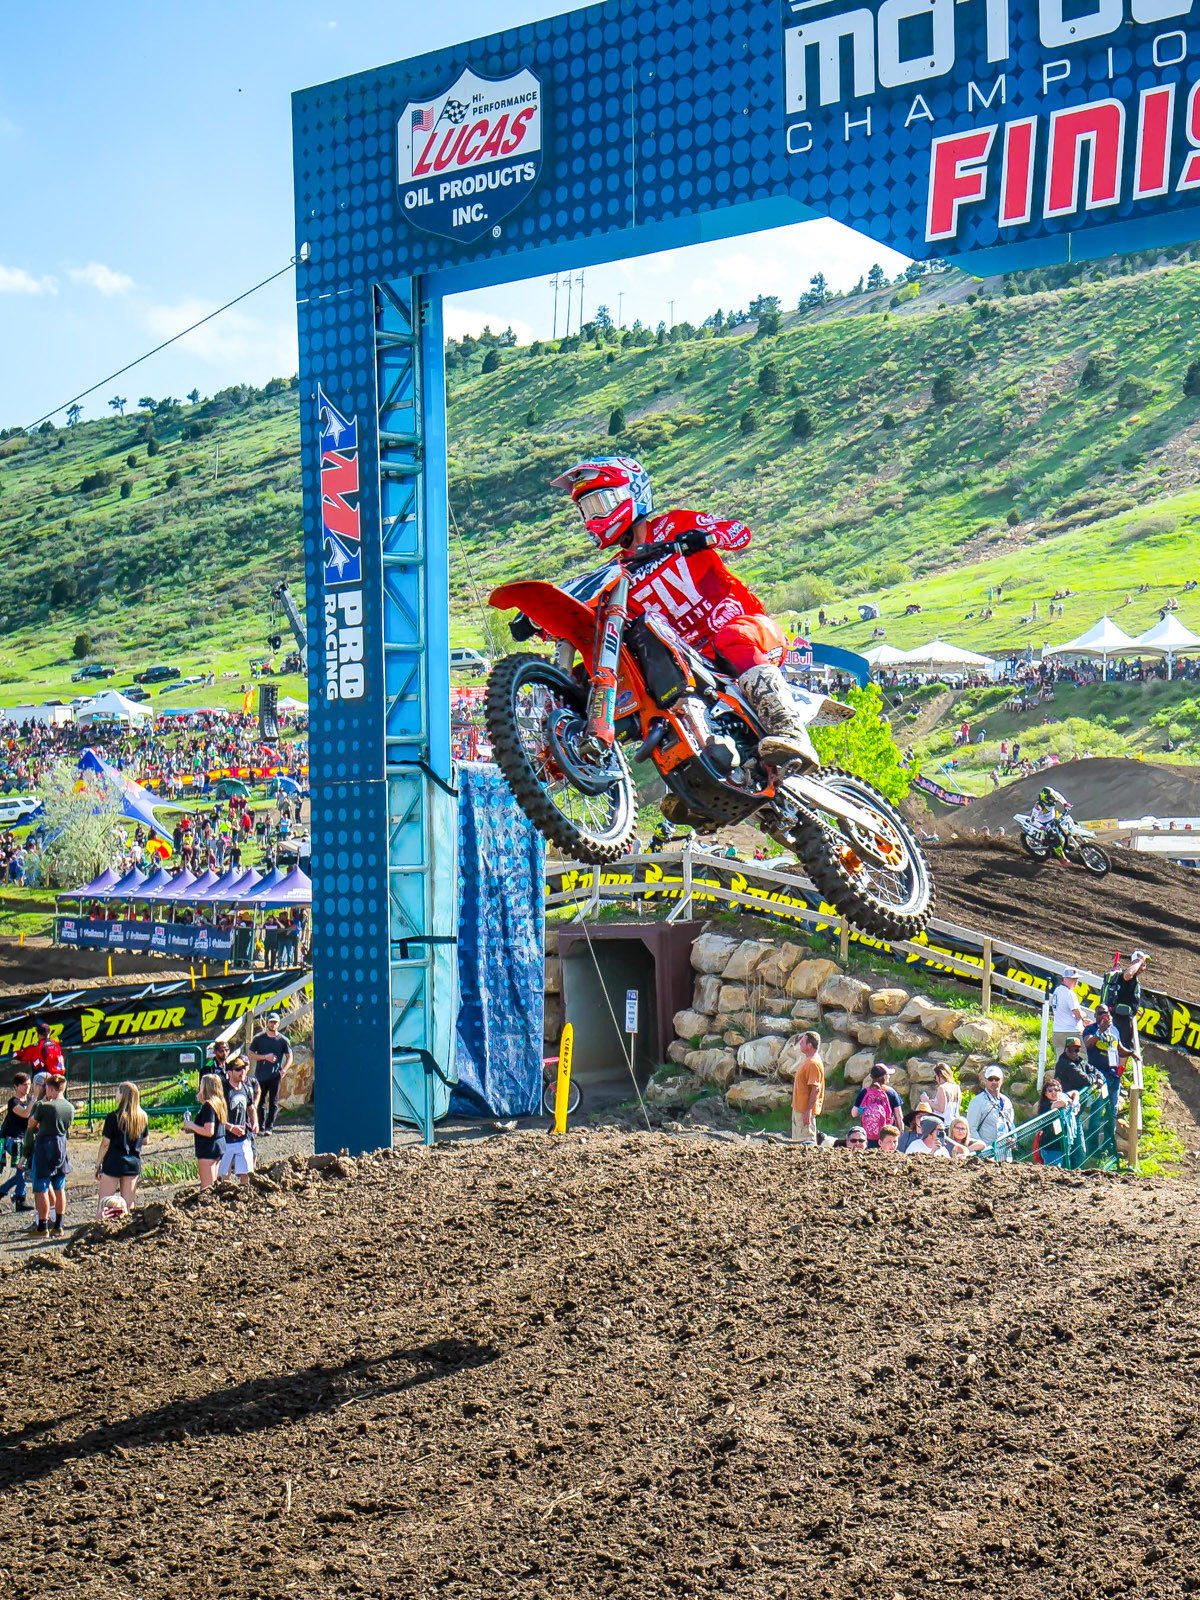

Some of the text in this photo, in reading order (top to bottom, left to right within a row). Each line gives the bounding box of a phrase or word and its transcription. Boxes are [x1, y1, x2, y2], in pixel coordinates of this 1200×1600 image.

[472, 93, 485, 103] HI-
[472, 91, 538, 116] PERFORMANCE
[412, 107, 535, 177] LUCAS
[404, 161, 536, 210] OIL PRODUCTS
[452, 203, 489, 227] INC.
[631, 555, 704, 621] FLY
[324, 593, 339, 701] RACING
[338, 589, 365, 699] PRO
[791, 651, 813, 665] Bull
[104, 1006, 186, 1036] THOR
[221, 988, 293, 1018] THOR
[562, 1037, 571, 1078] ACERBIS
